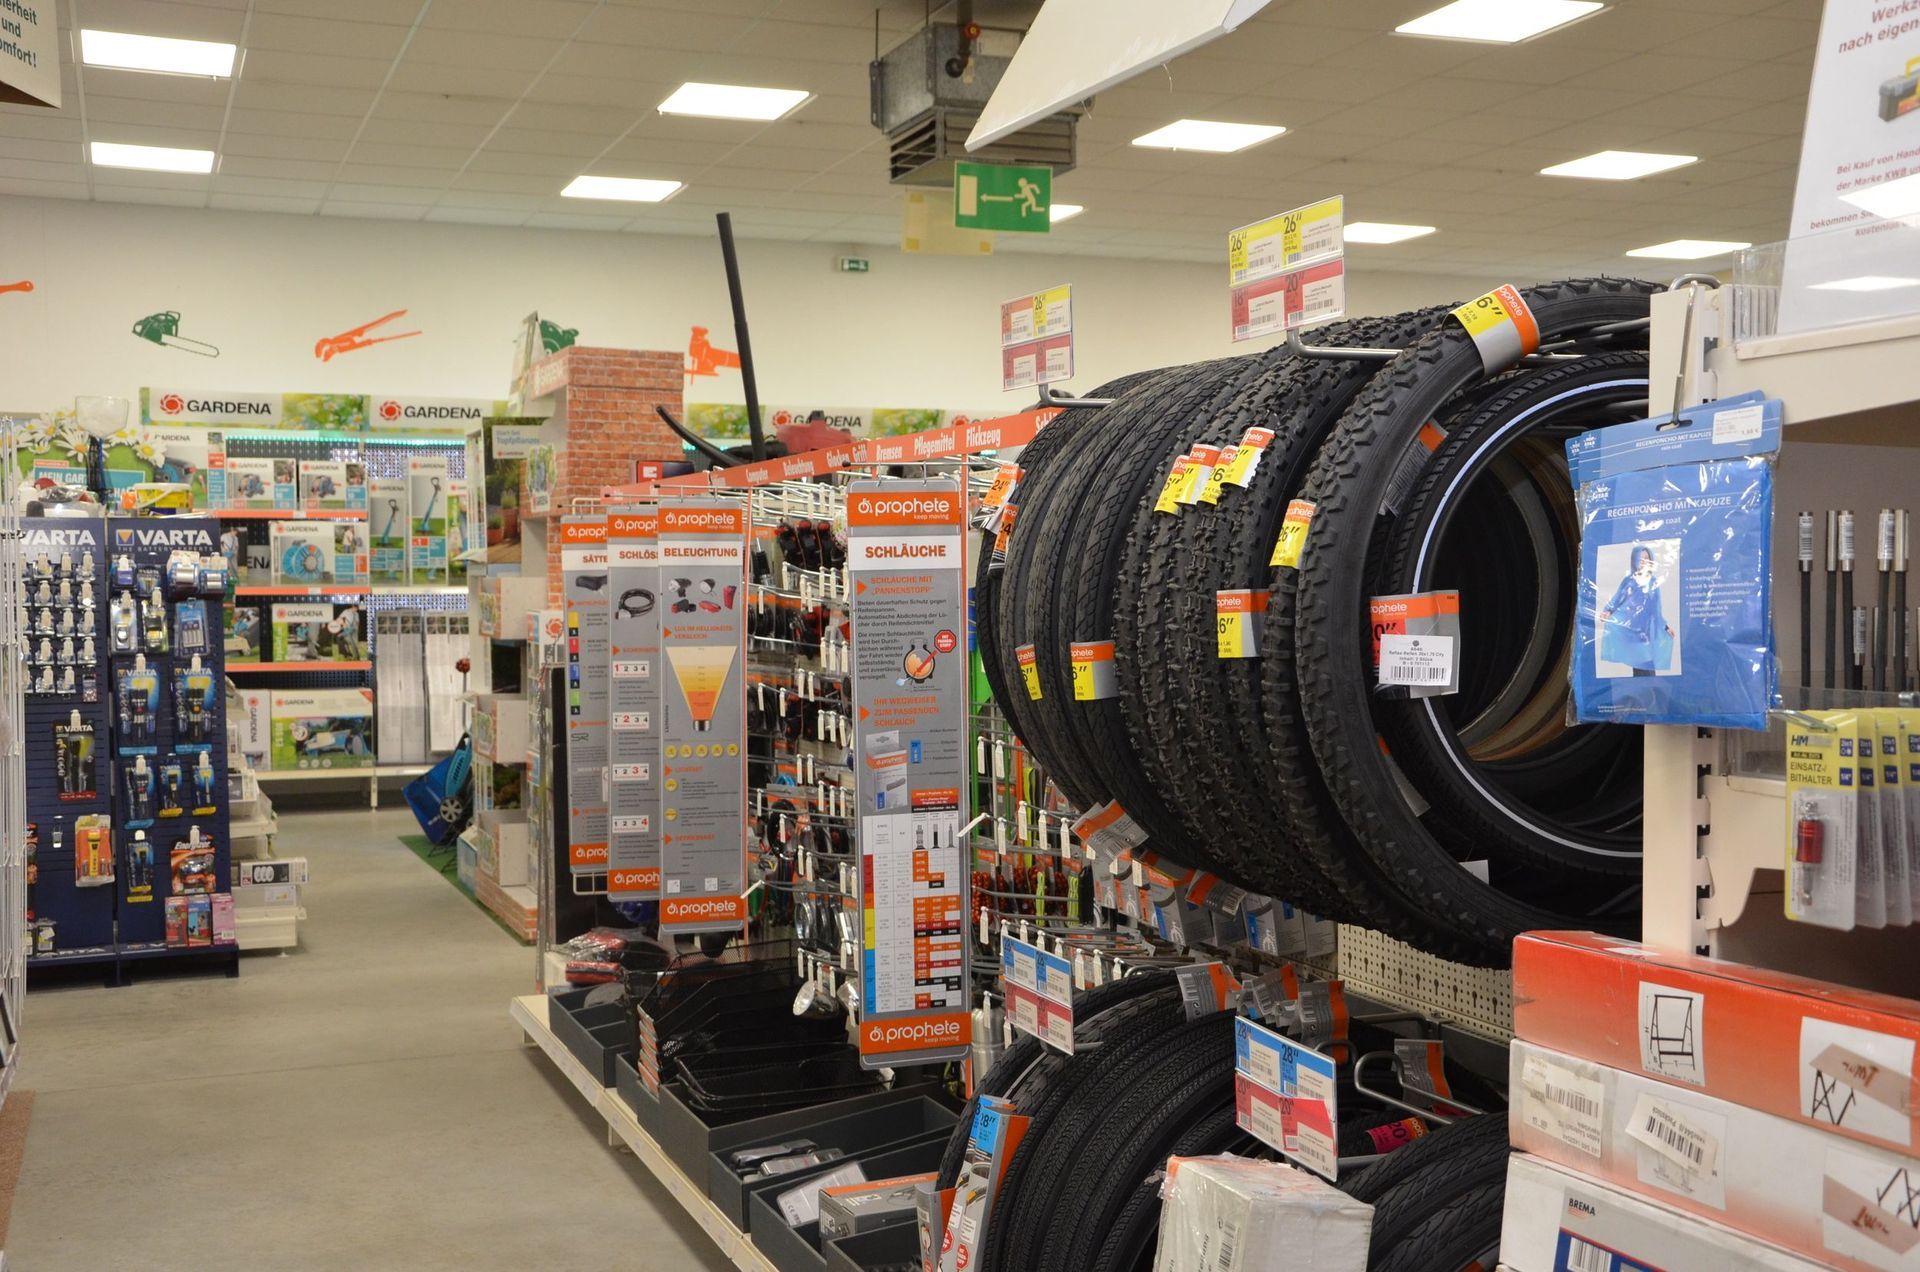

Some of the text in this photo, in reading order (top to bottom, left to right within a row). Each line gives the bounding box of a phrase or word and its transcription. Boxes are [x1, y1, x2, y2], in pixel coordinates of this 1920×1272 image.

[2, 17, 21, 38] und
[1838, 32, 1873, 54] nach
[1836, 165, 1851, 175] Bei
[1853, 158, 1875, 170] Kauf
[1877, 155, 1894, 165] von
[1836, 168, 1907, 191] der Marke KWB
[1810, 213, 1858, 230] bekommen
[187, 400, 271, 415] GARDENA
[404, 406, 481, 419] GARDENA
[794, 414, 861, 428] GADENA
[876, 445, 903, 462] Bremsen
[914, 431, 956, 458] Pflegemittel
[966, 424, 1001, 449] Flickzeug
[875, 498, 950, 516] prophete
[1607, 501, 1672, 518] REGENPONCHO
[1696, 496, 1732, 508] KAPUZE
[679, 512, 735, 527] prophete
[1666, 516, 1681, 524] coat
[137, 529, 213, 545] VARTA
[664, 547, 738, 557] BELEUCHTUNG
[865, 543, 946, 558] SCHLÄUCHE
[871, 576, 916, 584] SCHLÄUCHE
[614, 664, 619, 672] 1
[623, 715, 630, 723] 2
[632, 766, 639, 775] 3
[1791, 773, 1832, 785] BITHALTER
[641, 818, 648, 826] 4
[680, 901, 736, 916] prophete
[887, 1020, 960, 1043] prophete
[1568, 1197, 1596, 1216] BREMA
